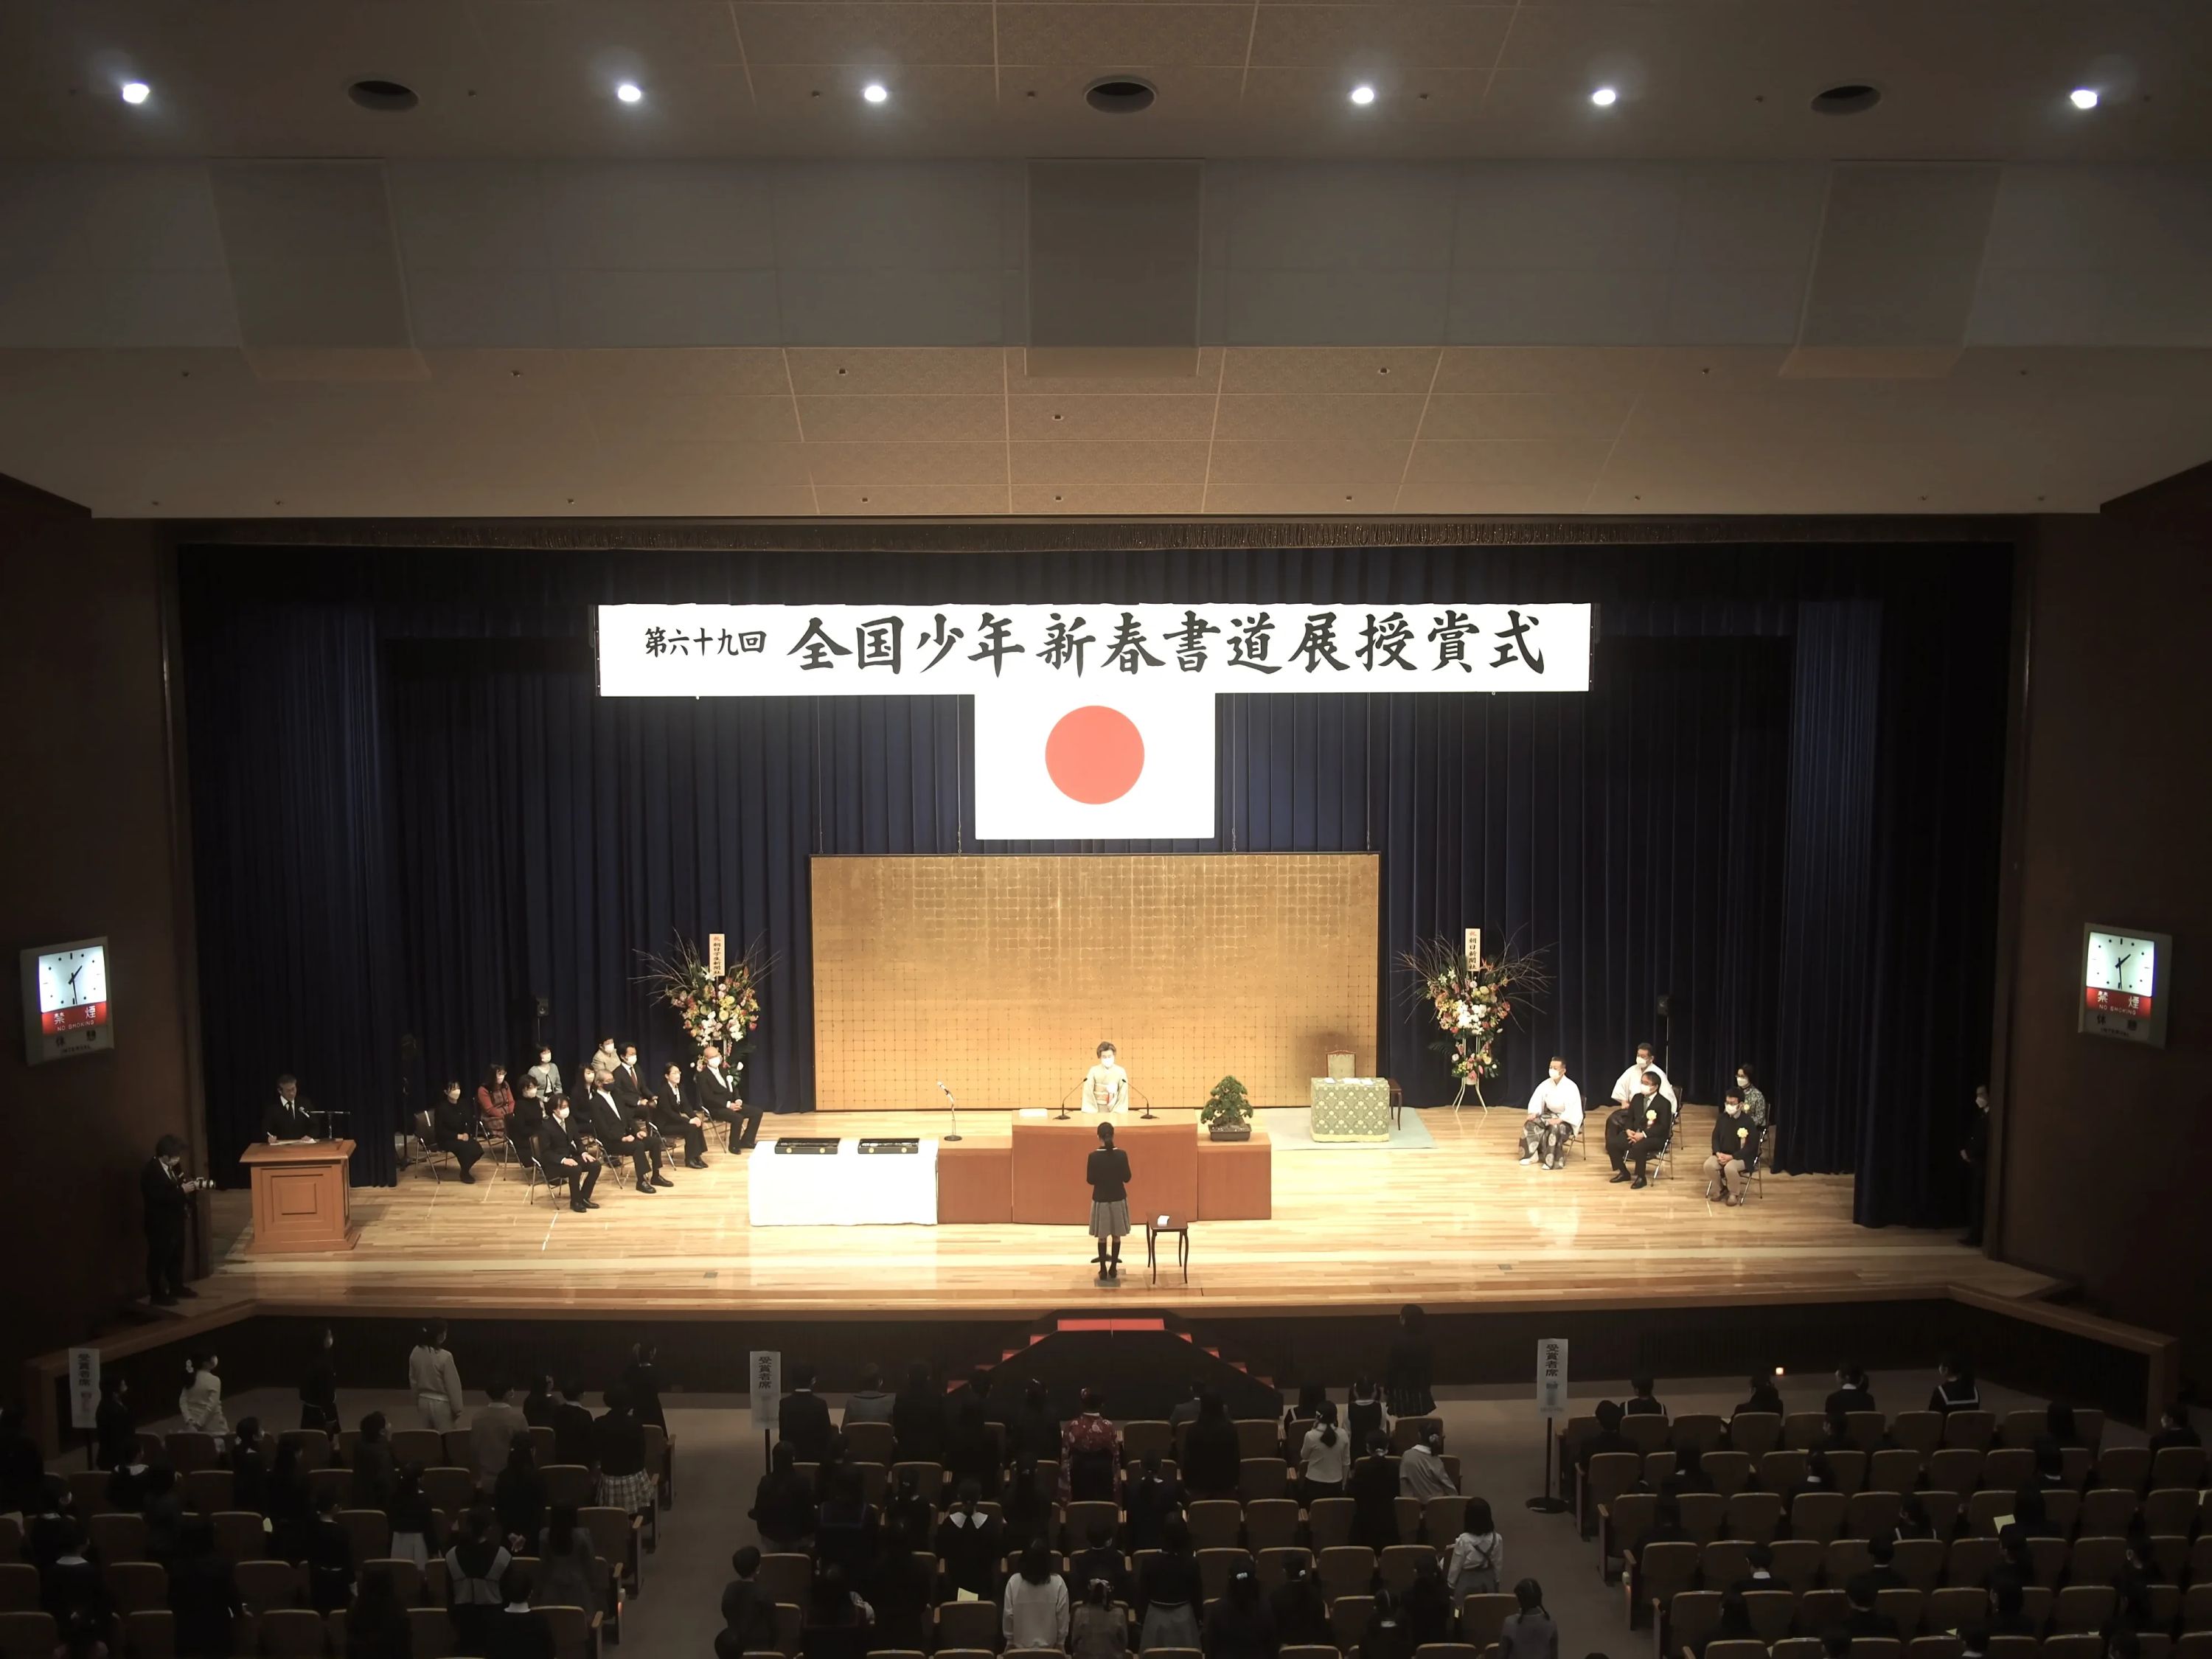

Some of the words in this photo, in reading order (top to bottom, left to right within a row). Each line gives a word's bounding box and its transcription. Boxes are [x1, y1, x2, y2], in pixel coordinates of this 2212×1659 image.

[644, 625, 767, 658] 第六十九回
[786, 610, 1545, 678] 全国少年新春書道展授賞式
[69, 1020, 94, 1030] SMOKING
[759, 1357, 772, 1389] 受賞者席
[1545, 1343, 1559, 1377] 受賞者席
